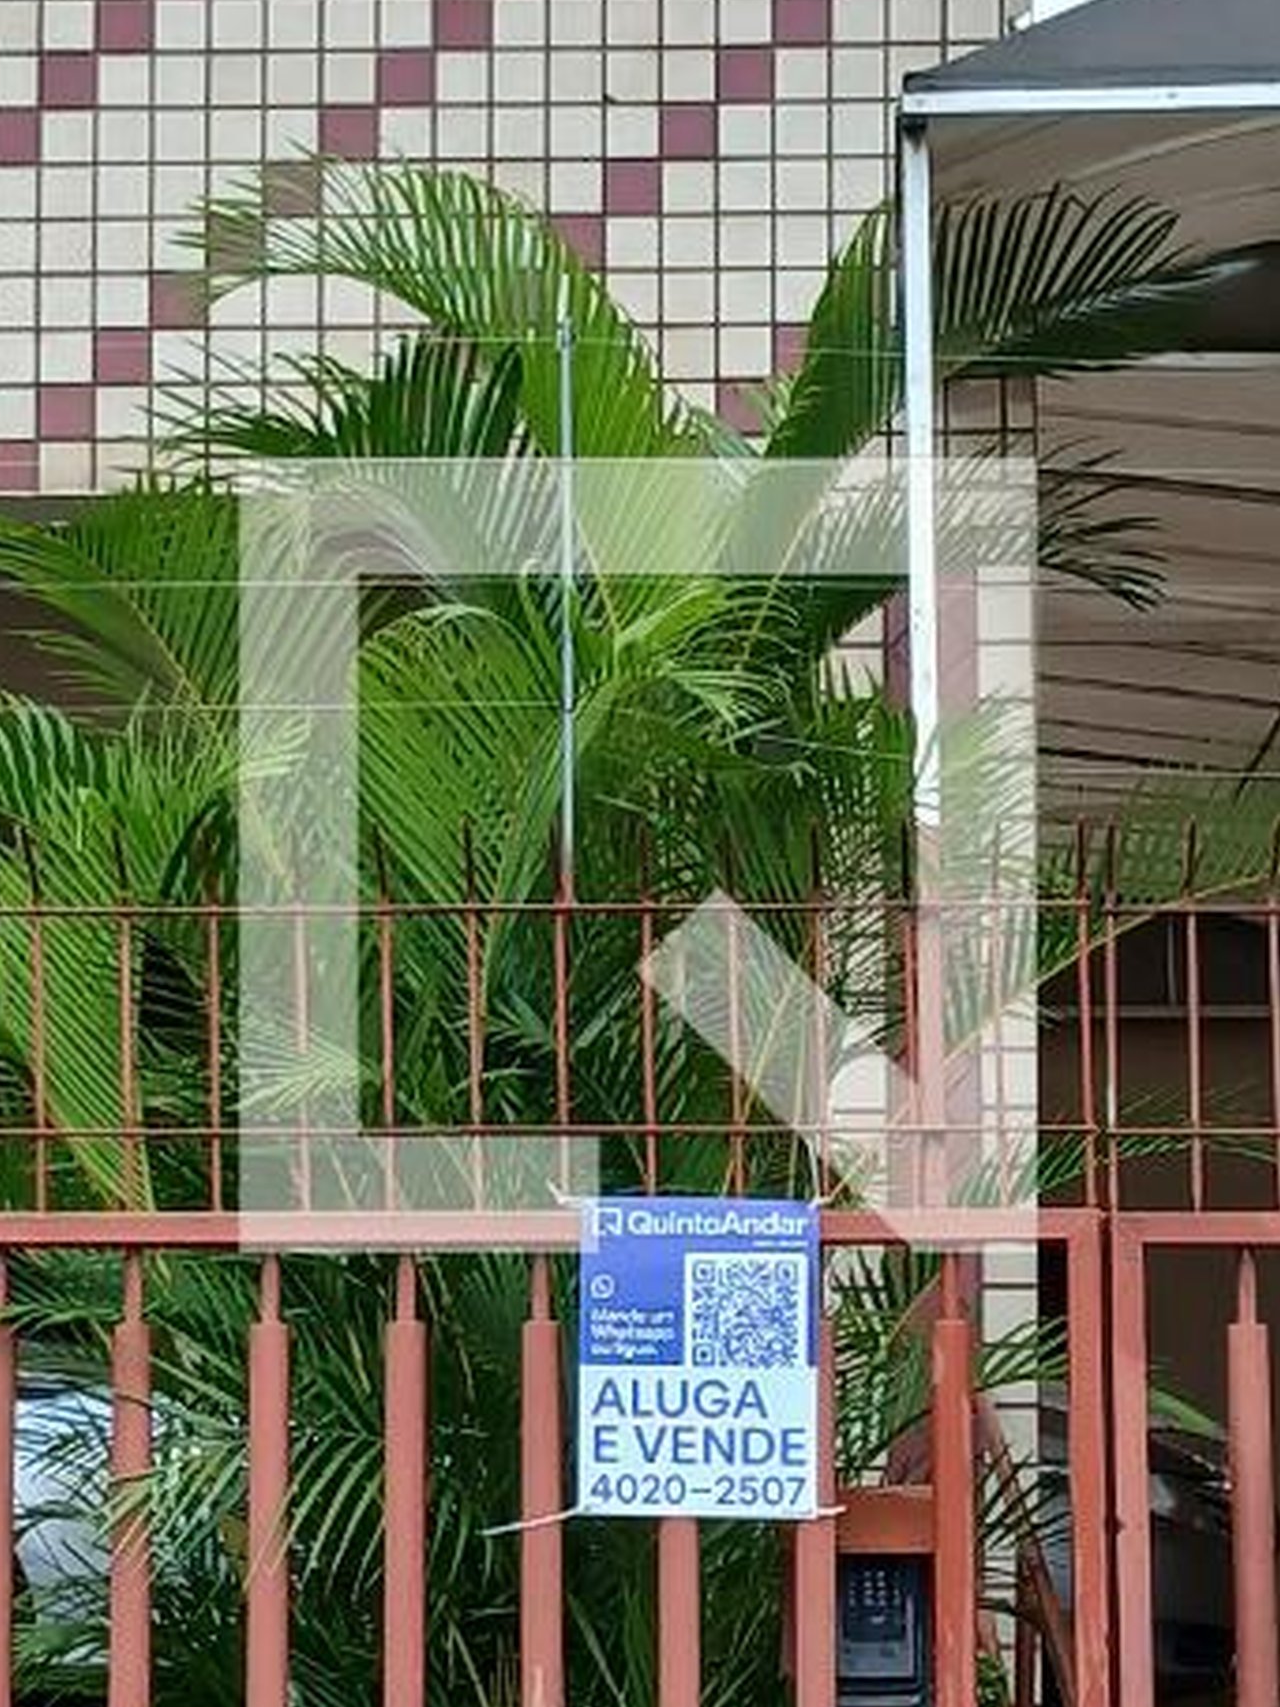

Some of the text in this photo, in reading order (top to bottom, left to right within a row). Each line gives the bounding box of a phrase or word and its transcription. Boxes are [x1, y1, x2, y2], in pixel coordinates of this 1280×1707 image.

[627, 1210, 808, 1237] QuintoAndar
[591, 1378, 768, 1419] ALUGA
[593, 1425, 808, 1466] E VENDE
[590, 1473, 807, 1506] 4020-2507
